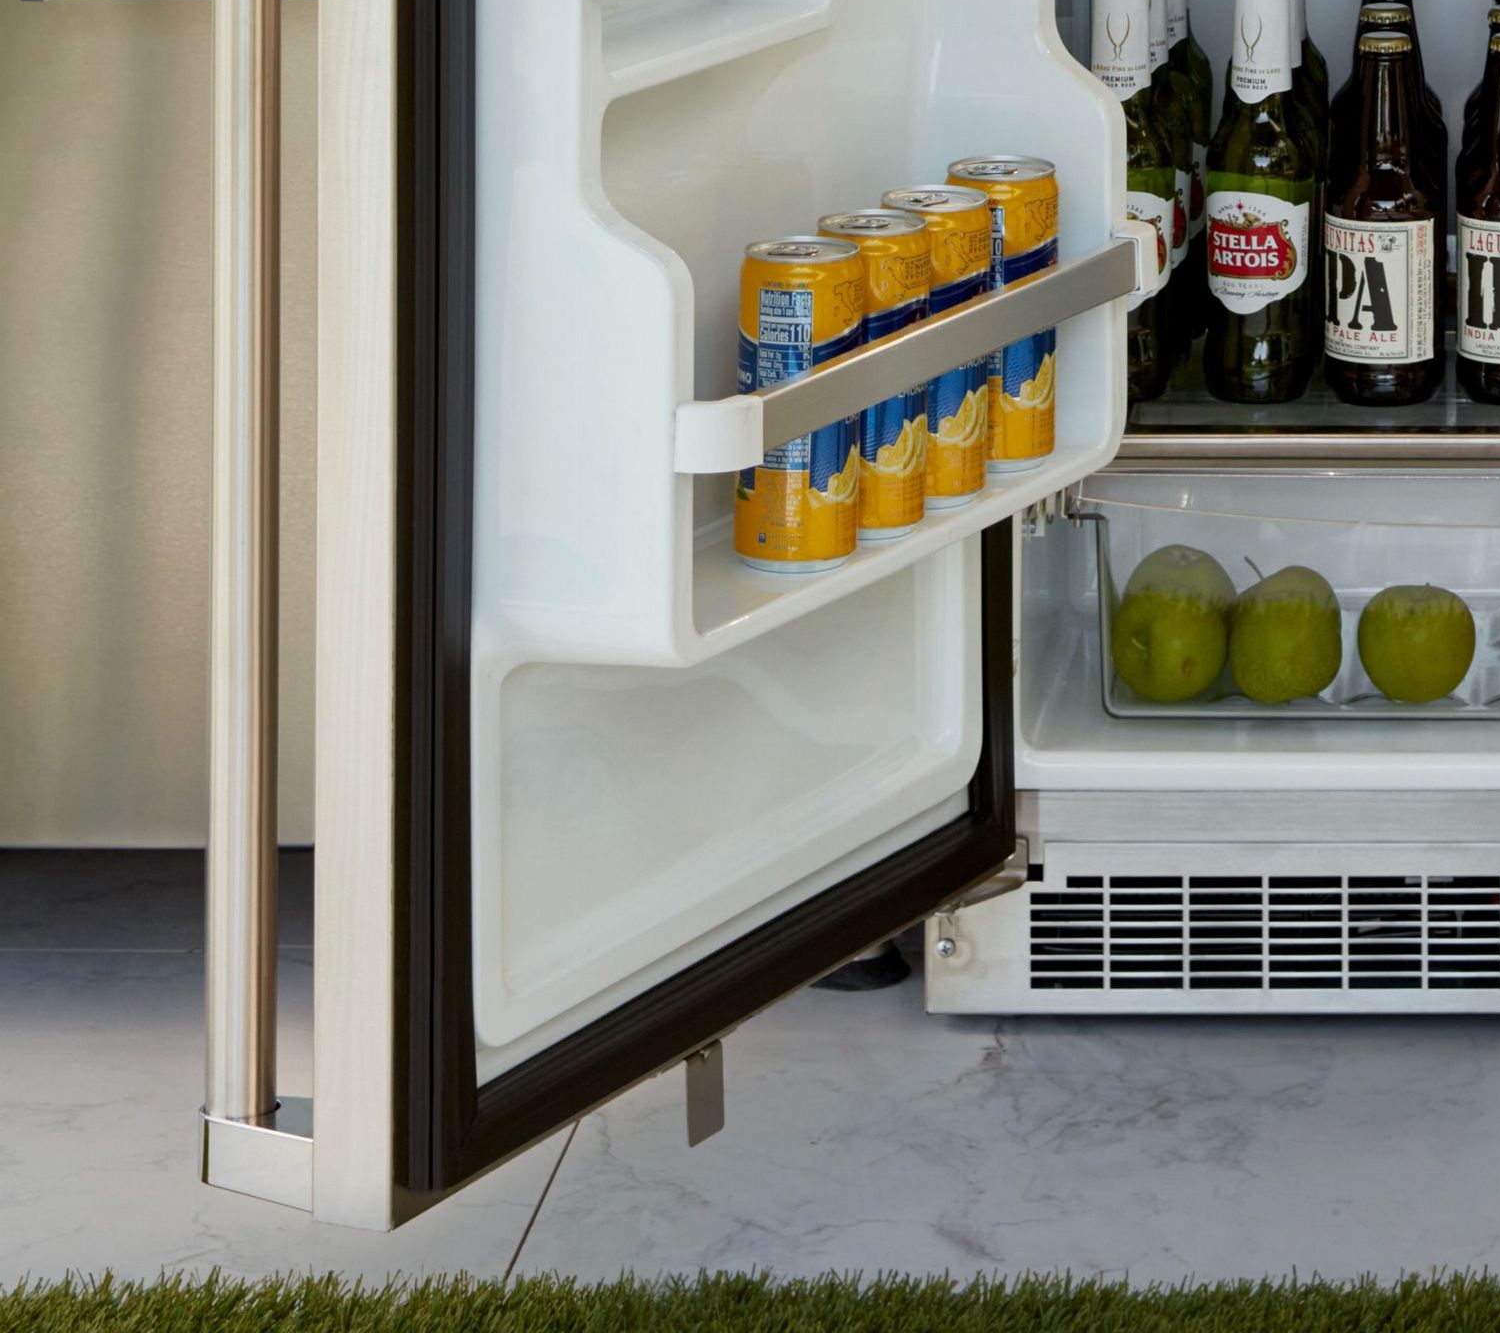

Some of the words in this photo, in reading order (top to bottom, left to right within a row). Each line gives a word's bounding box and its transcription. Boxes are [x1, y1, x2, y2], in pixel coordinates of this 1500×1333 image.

[1236, 75, 1266, 84] PREMIUM
[1213, 231, 1278, 250] STELLA
[1213, 249, 1280, 268] ARTOIS
[760, 290, 790, 306] Nutrition
[791, 292, 812, 307] Facts
[1327, 249, 1398, 331] PA
[760, 326, 790, 342] Calories
[790, 324, 811, 342] 110
[1333, 325, 1361, 341] PALE
[1369, 331, 1398, 343] ALE
[1464, 325, 1495, 342] INDIA
